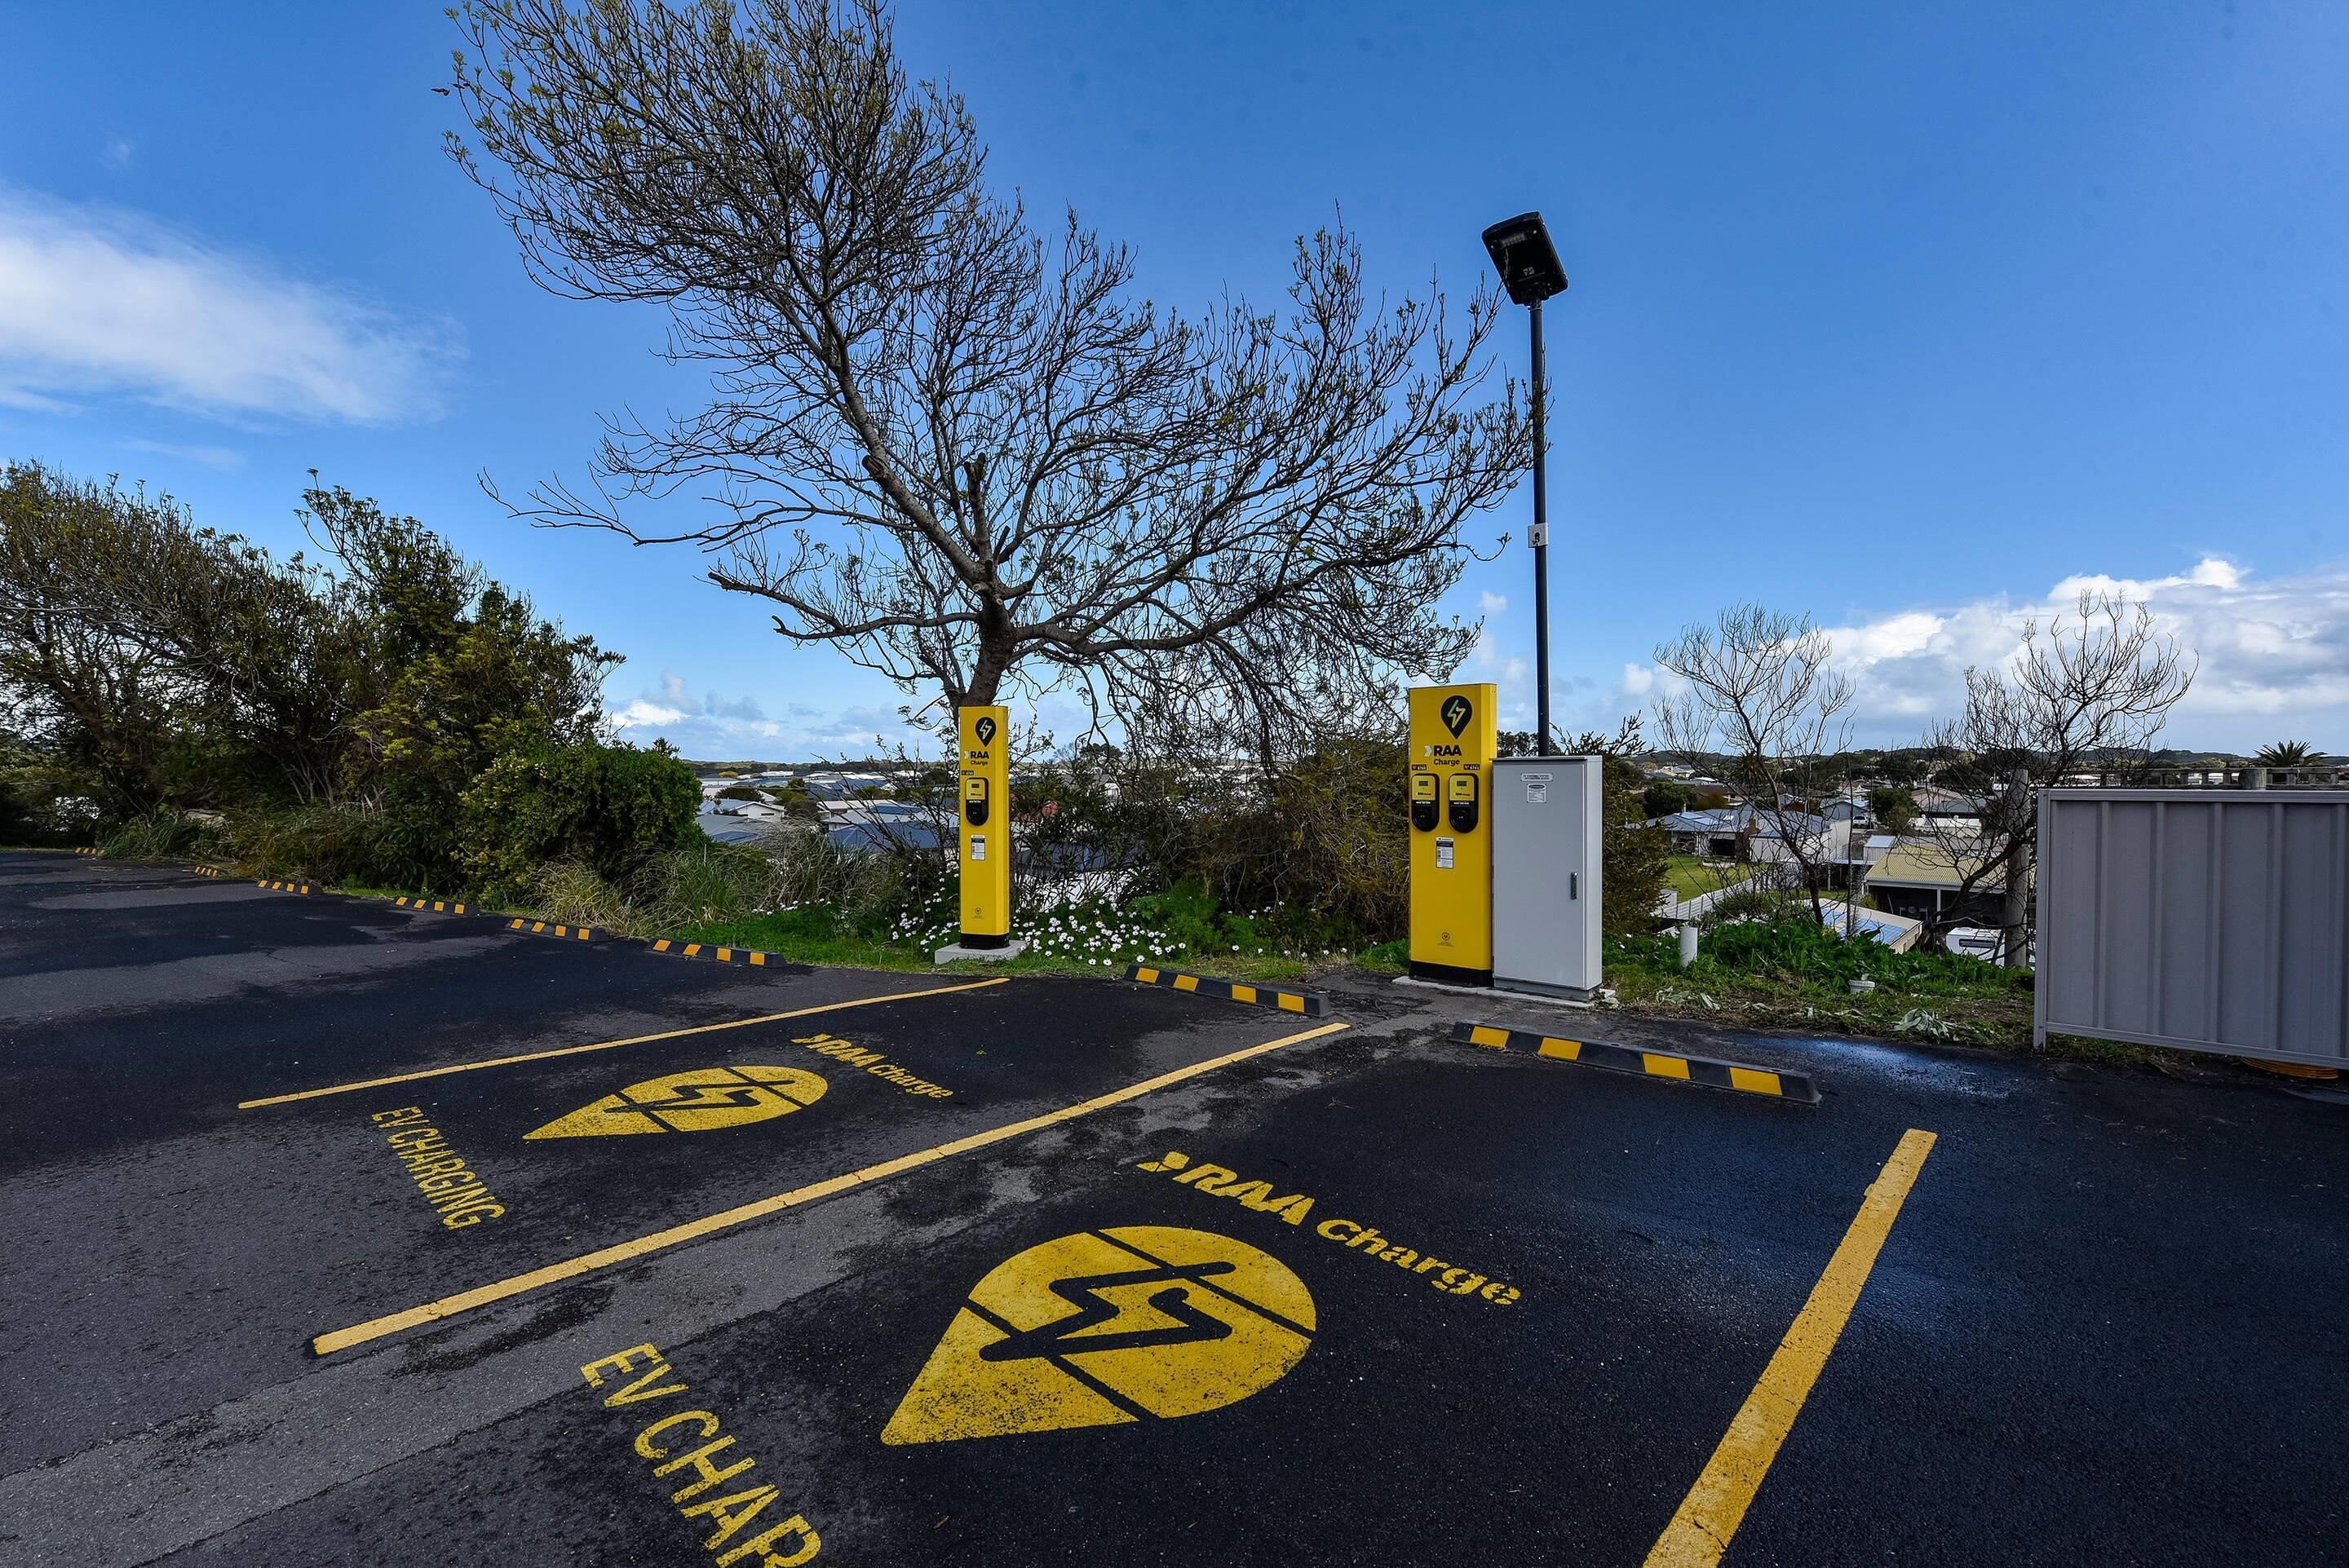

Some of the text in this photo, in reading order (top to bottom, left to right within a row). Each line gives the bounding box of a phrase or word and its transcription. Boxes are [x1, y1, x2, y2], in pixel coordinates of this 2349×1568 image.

[971, 751, 989, 759] RAA
[1434, 744, 1462, 756] RAA
[1434, 758, 1460, 766] Charge
[806, 1039, 953, 1098] RAA Charge
[371, 1106, 507, 1230] EV CHARGING
[1172, 1163, 1522, 1305] RAA Charge
[580, 1343, 689, 1407] EV
